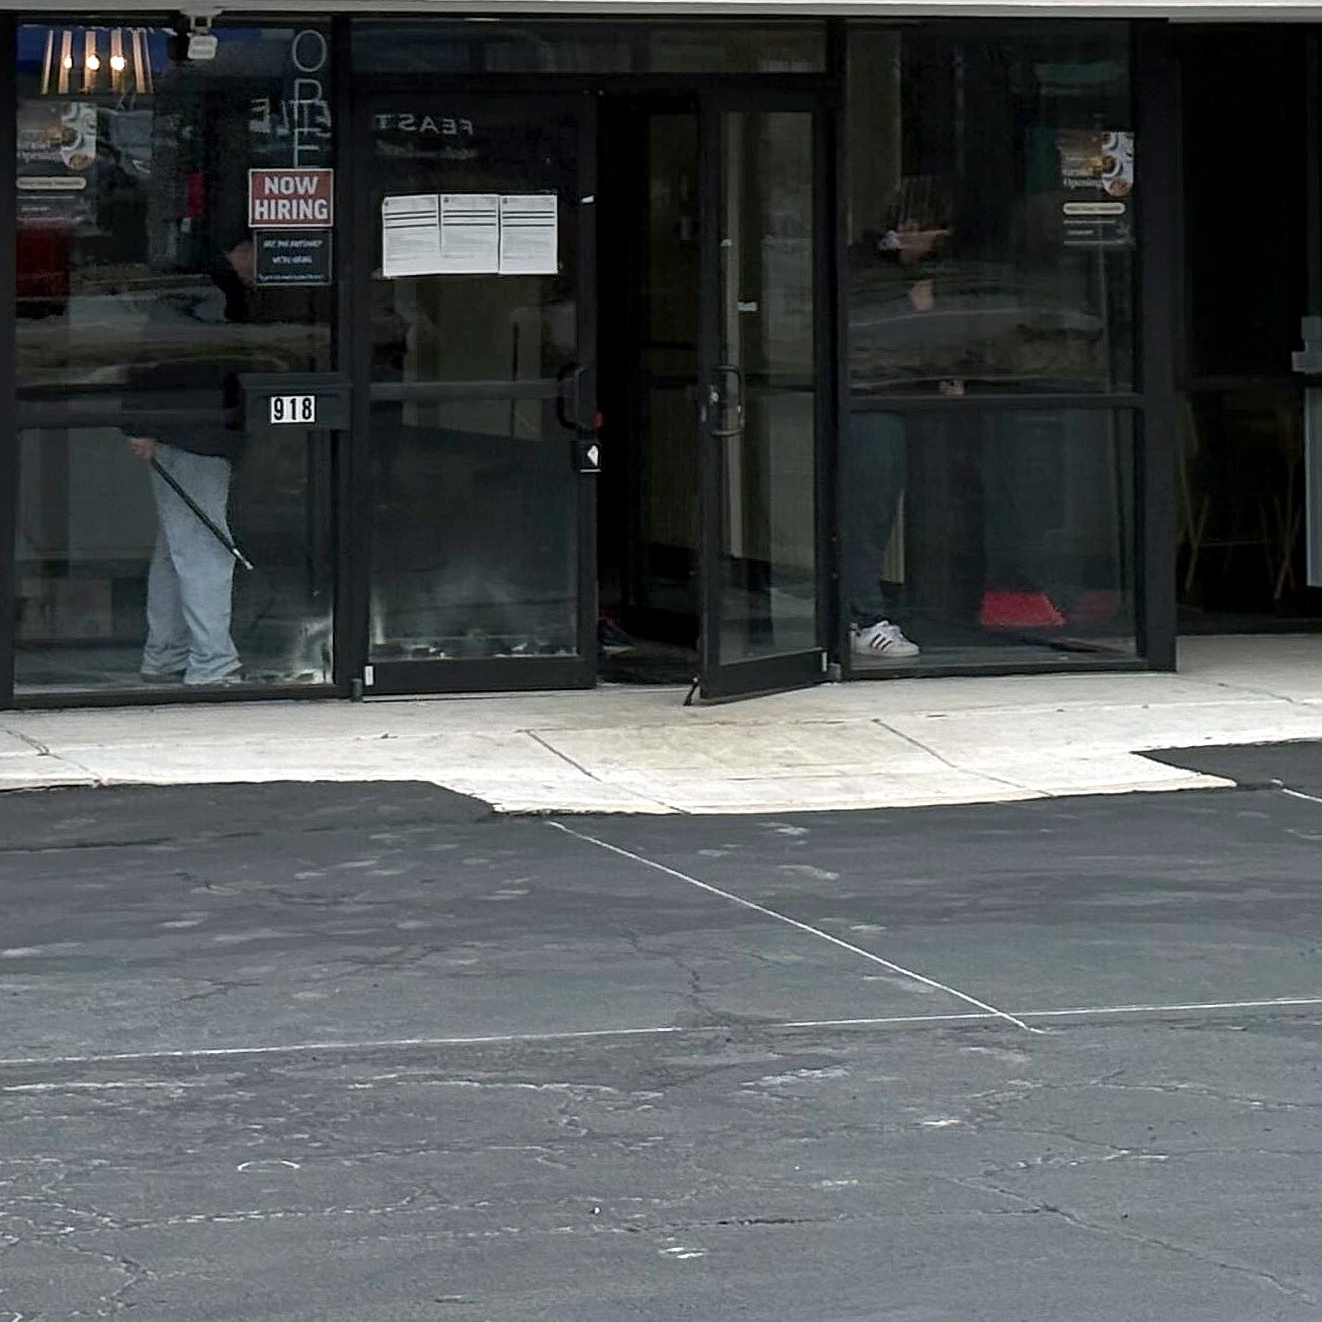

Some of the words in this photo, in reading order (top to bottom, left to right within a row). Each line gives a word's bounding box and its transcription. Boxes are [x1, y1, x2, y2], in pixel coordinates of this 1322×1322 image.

[264, 176, 319, 196] NOW
[254, 199, 328, 220] HIRING
[273, 397, 312, 421] 918
